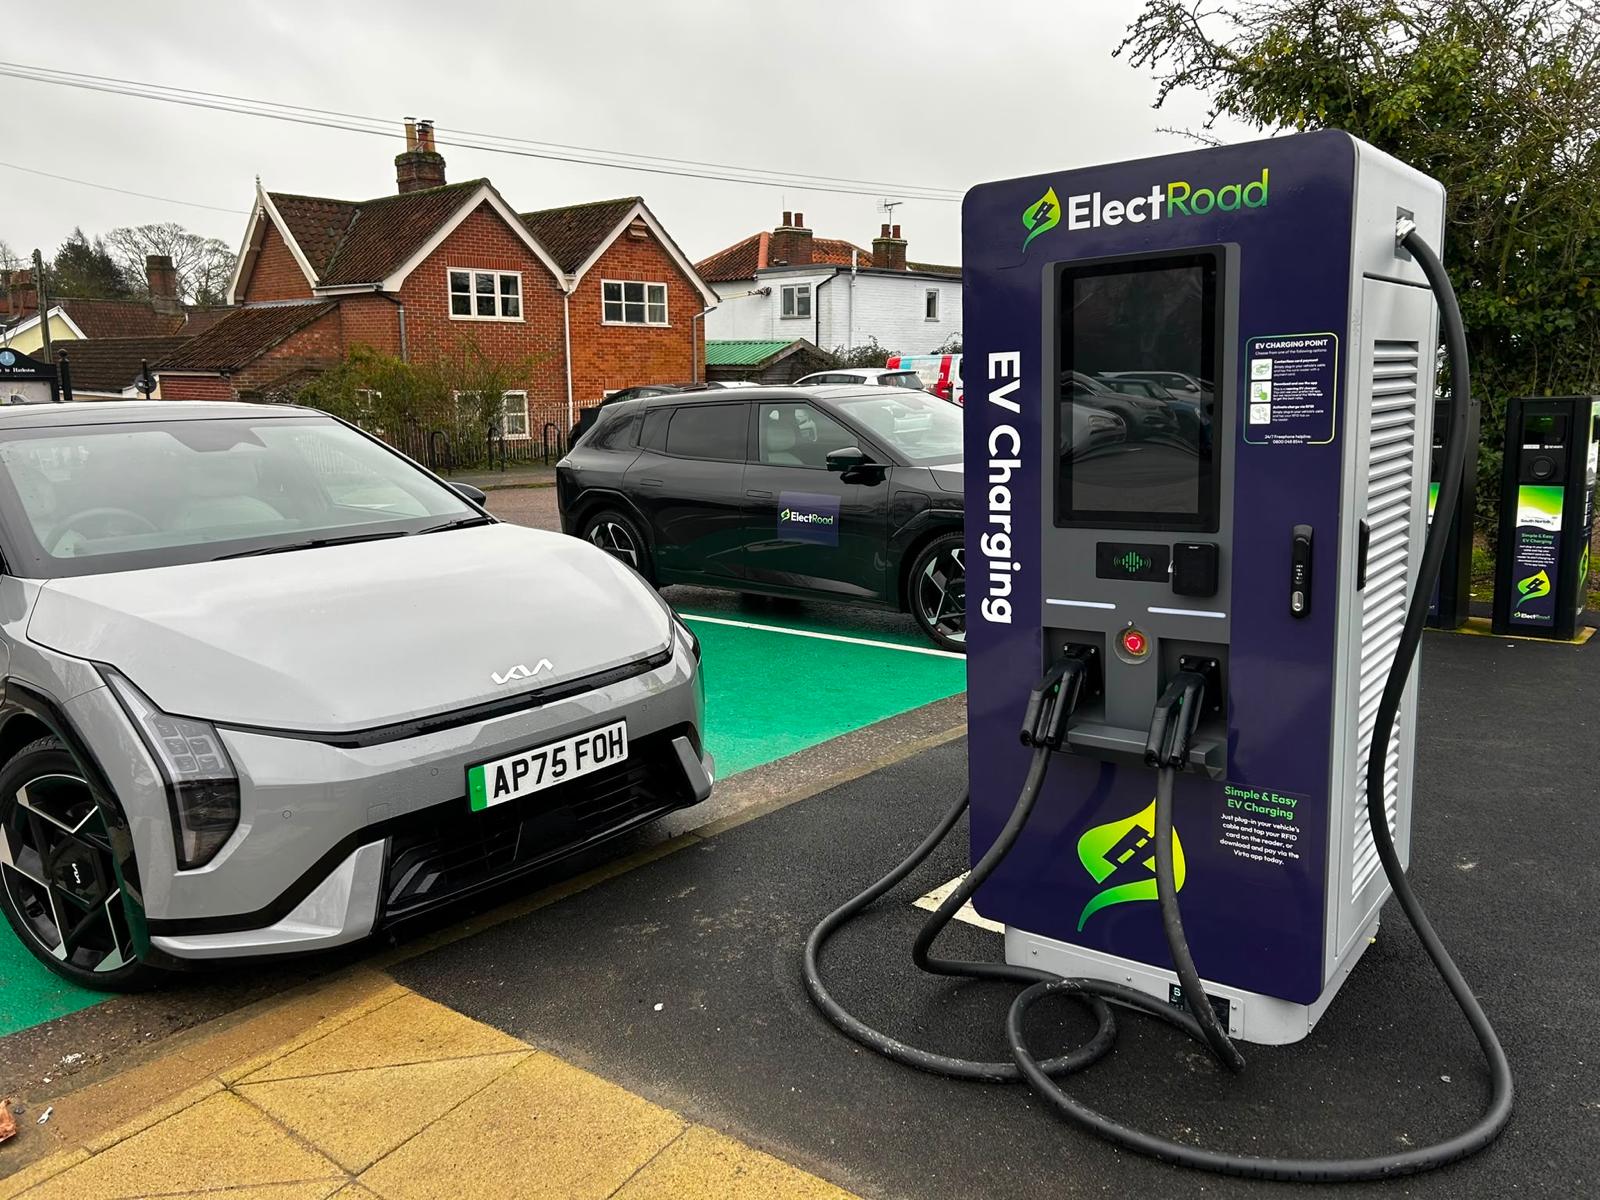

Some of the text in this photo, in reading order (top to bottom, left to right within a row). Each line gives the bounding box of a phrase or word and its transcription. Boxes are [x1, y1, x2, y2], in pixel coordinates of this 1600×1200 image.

[1068, 168, 1269, 231] ElectRoad
[1265, 340, 1304, 349] CHARGING
[980, 351, 1021, 624] EV Charging
[791, 511, 833, 525] ElectRoad
[494, 727, 624, 799] AP75 FOH
[1225, 786, 1298, 808] Simple & Easy
[1227, 798, 1294, 820] EV Charging
[1234, 816, 1257, 824] plug-in
[1272, 823, 1300, 833] vehicle's
[1253, 828, 1265, 836] tap
[1281, 832, 1298, 841] RFID
[1261, 839, 1285, 848] reader,
[1220, 838, 1250, 849] download
[1288, 851, 1299, 859] the
[1233, 849, 1250, 858] Virta
[1264, 856, 1285, 865] today.
